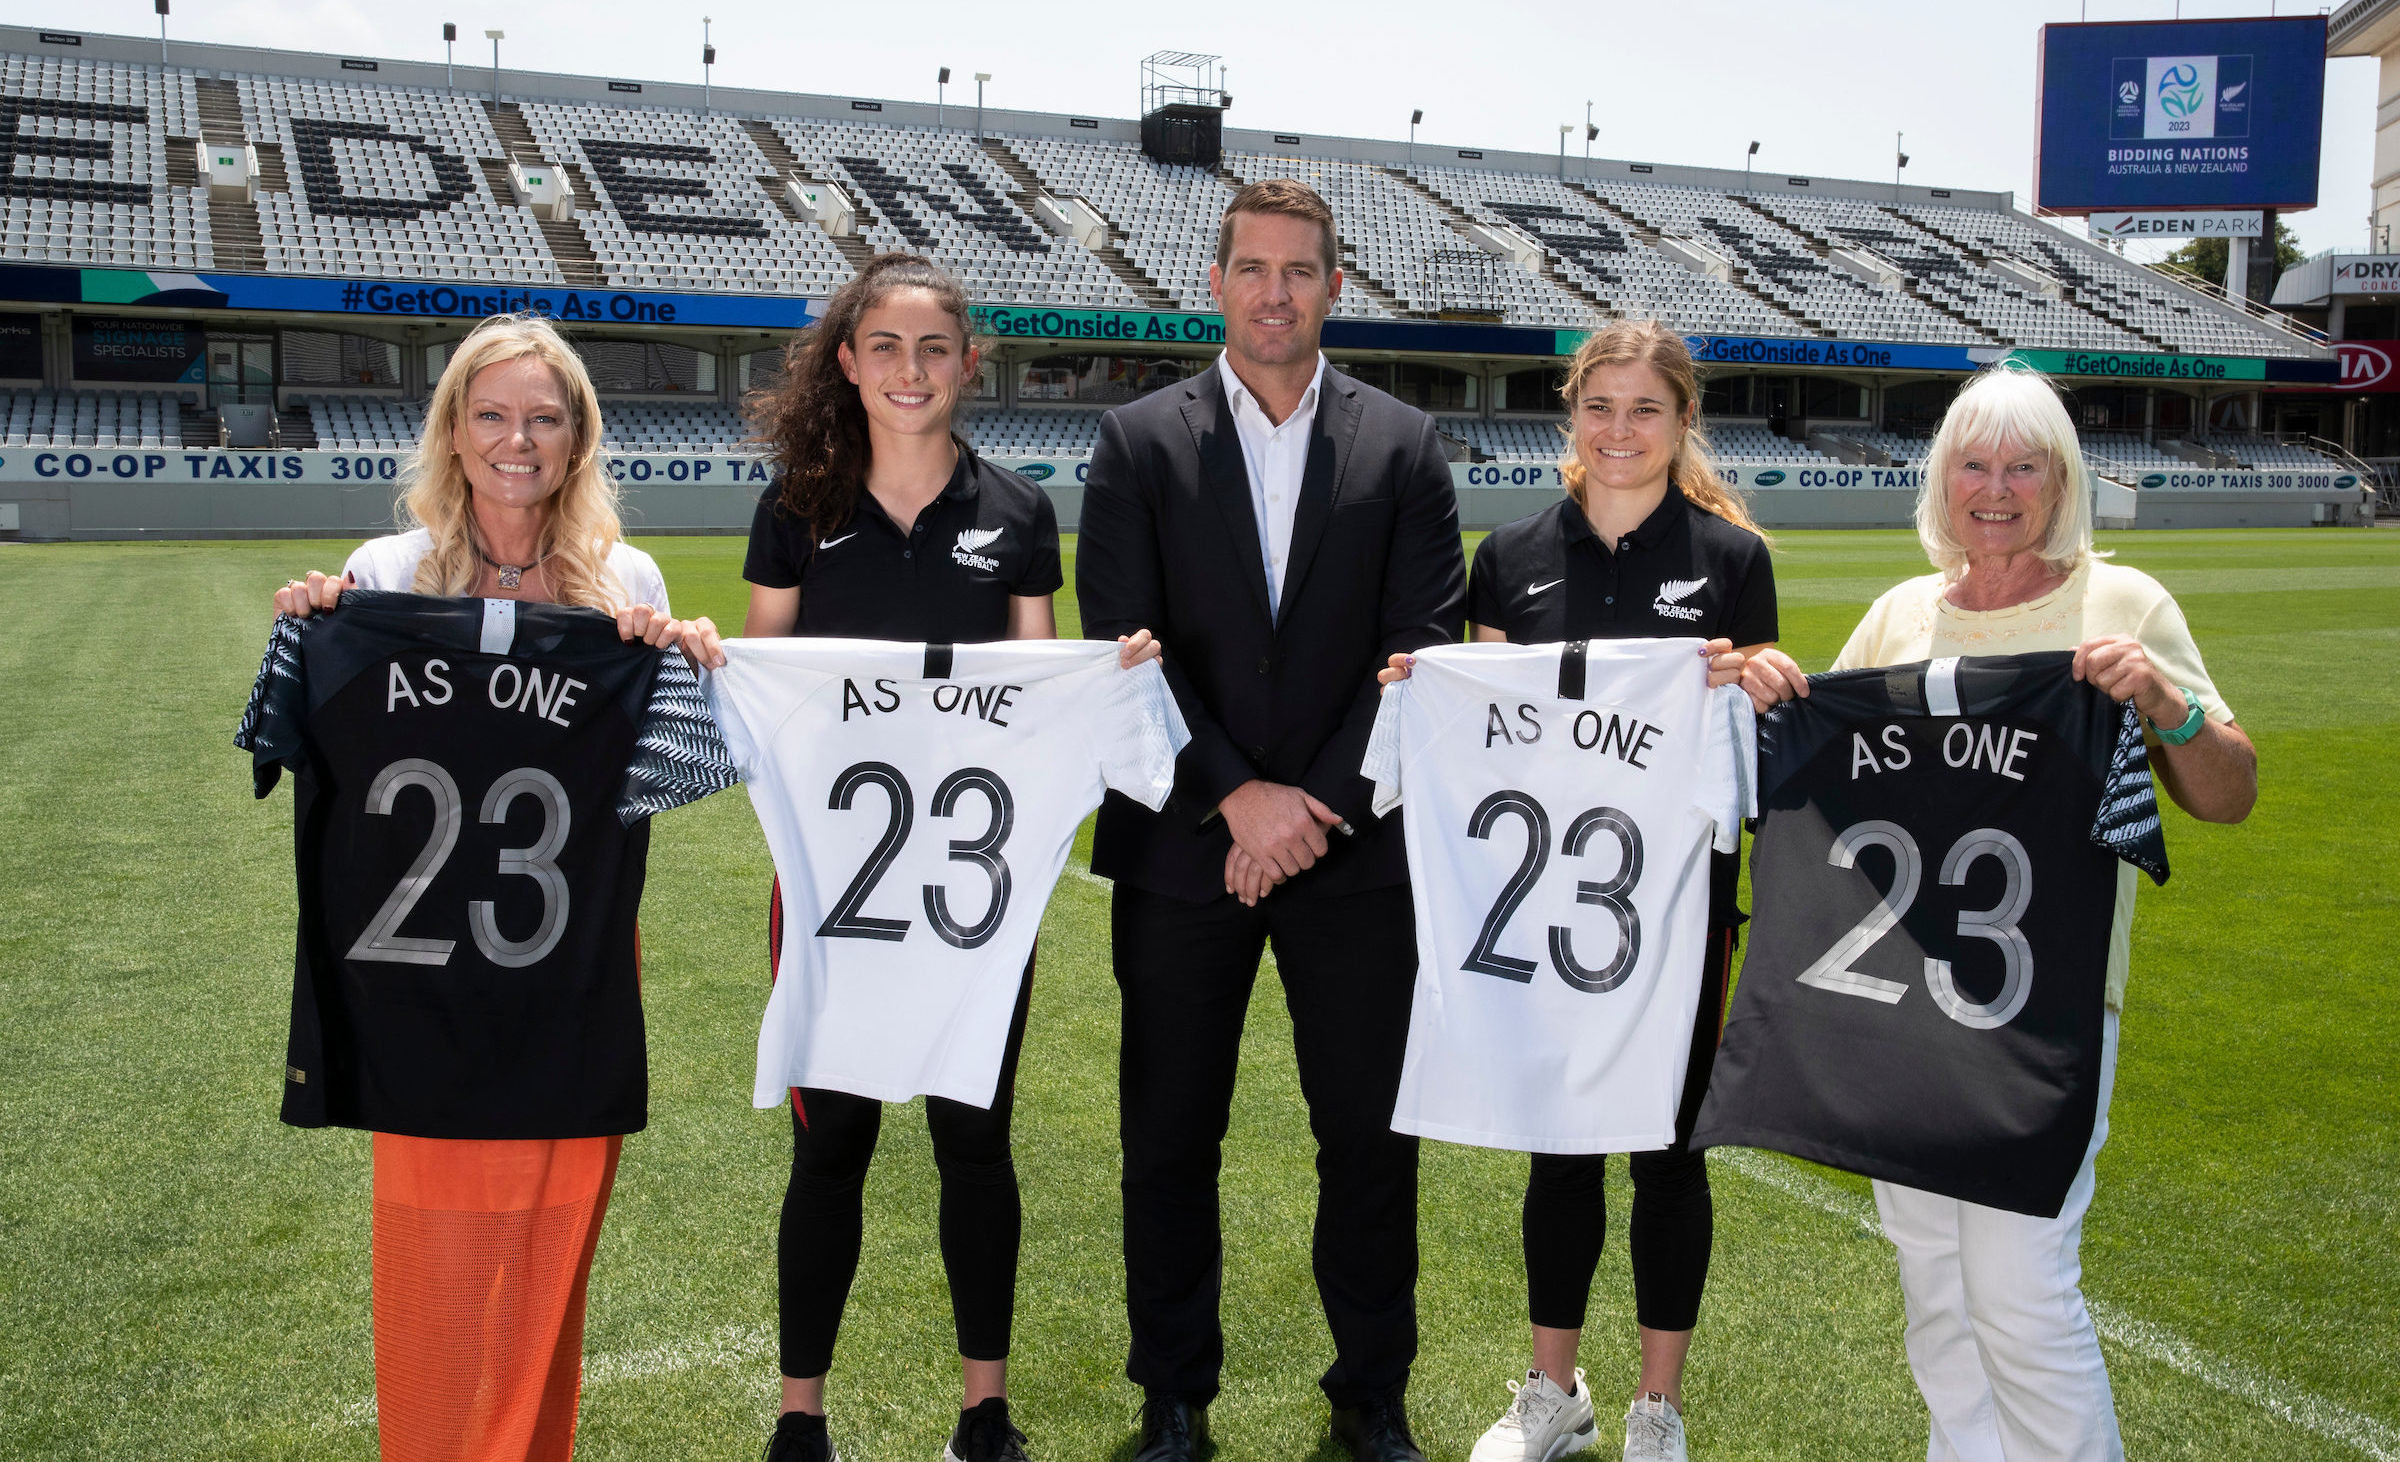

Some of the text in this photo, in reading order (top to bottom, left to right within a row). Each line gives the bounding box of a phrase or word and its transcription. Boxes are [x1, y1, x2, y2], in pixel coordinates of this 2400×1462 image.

[2168, 121, 2190, 131] 2023
[2108, 147, 2248, 162] BIDDING NATIONS
[2108, 162, 2248, 175] AUSTRALIA & NEW ZEALAND
[2138, 217, 2261, 233] EDEN PARK
[2355, 262, 2400, 279] DRY
[342, 281, 676, 322] #GetOnside As One
[92, 320, 184, 331] YOUR NATIONWIDE
[972, 307, 1226, 341] #GetOnside As On
[93, 344, 186, 359] SPECIALISTS
[1701, 338, 1891, 365] #GetOnside As One
[2065, 354, 2225, 377] #GetOnside As One
[2340, 354, 2376, 378] IA
[34, 453, 397, 479] CO-OP TAXIS 300
[606, 459, 711, 481] CO-OP
[1468, 467, 1542, 485] CO-OP
[1799, 470, 1862, 487] CO-OP
[2171, 474, 2215, 488] CO-OP
[2221, 475, 2262, 488] TAXIS
[2268, 475, 2292, 488] 300
[2298, 475, 2329, 488] 3000
[952, 552, 999, 567] NEW ZEALAND
[957, 559, 994, 572] FOOTBALL
[1658, 610, 1697, 621] FOOTBALL
[1670, 605, 1703, 617] ZEALAND
[387, 658, 587, 728] AS ONE
[842, 678, 1023, 728] AS ONE
[1485, 703, 1664, 771] AS ONE
[1851, 722, 2038, 781] AS ONE
[344, 757, 572, 968] 23
[815, 761, 1015, 949] 23
[1459, 789, 1644, 994] 23
[1795, 819, 2034, 1030] 23
